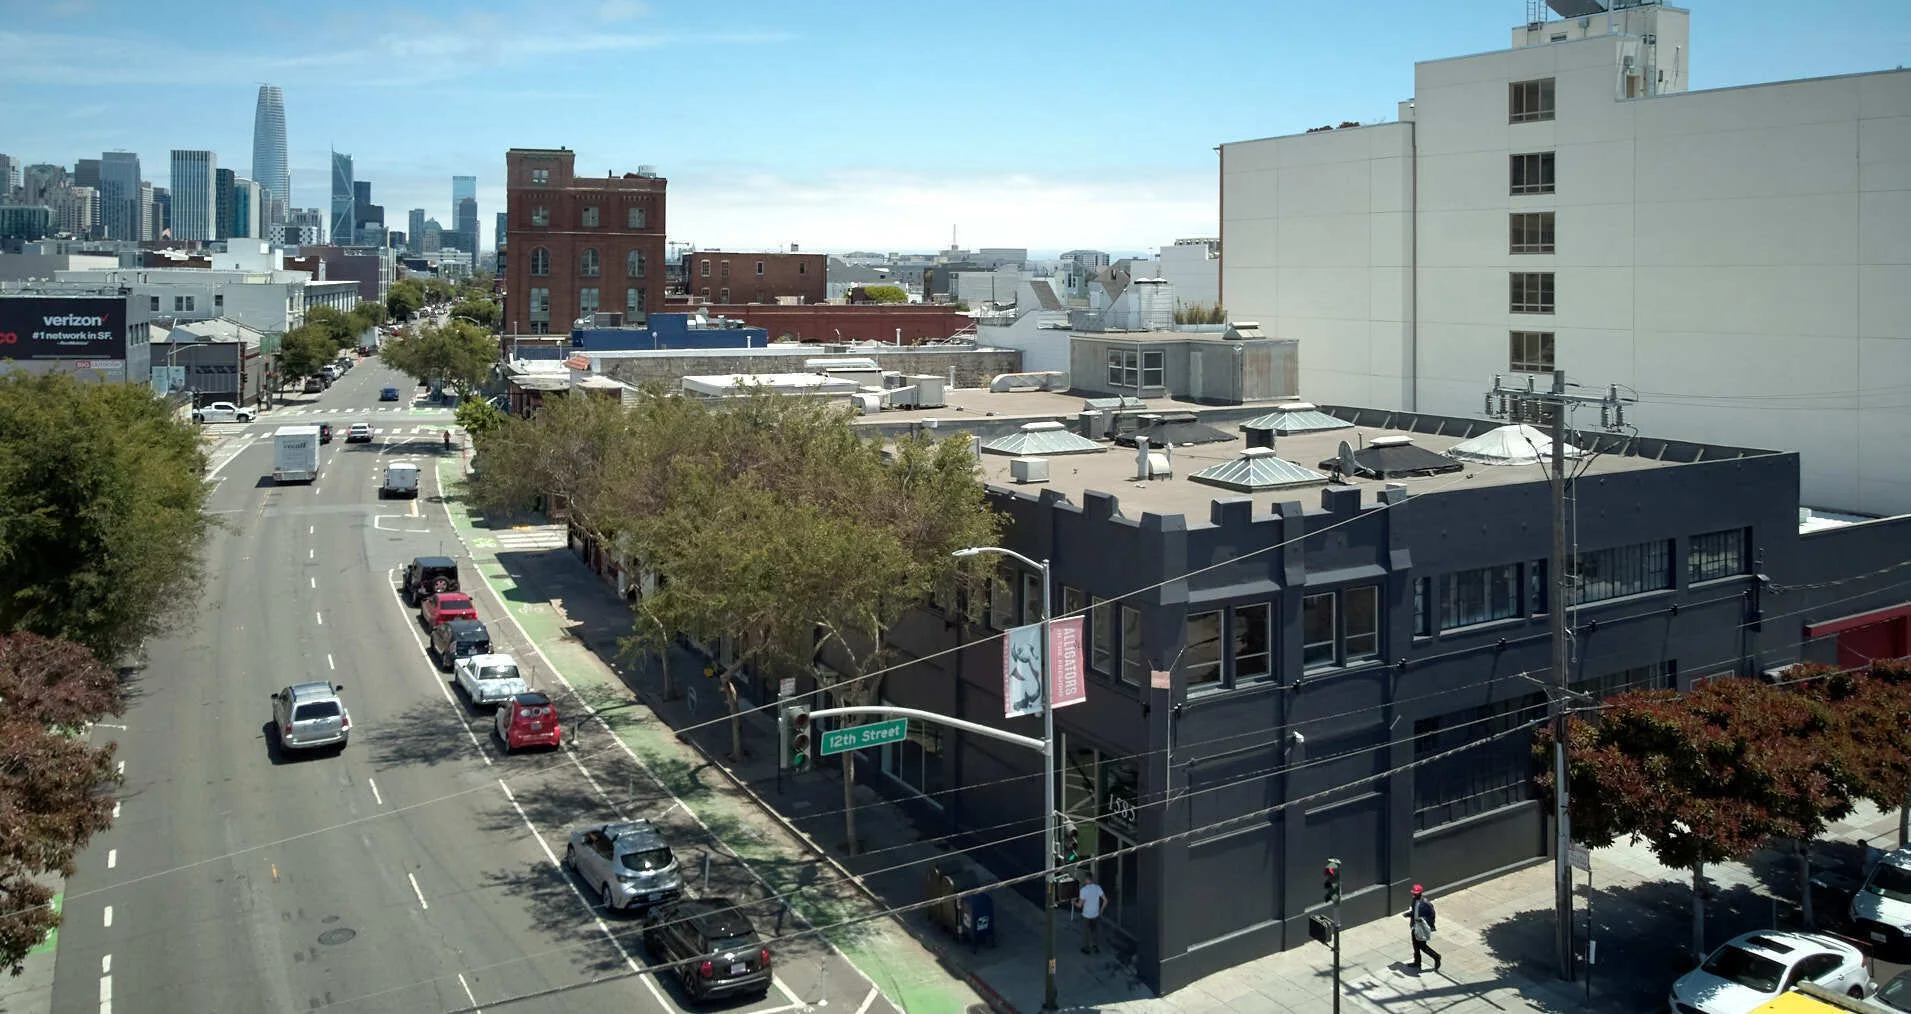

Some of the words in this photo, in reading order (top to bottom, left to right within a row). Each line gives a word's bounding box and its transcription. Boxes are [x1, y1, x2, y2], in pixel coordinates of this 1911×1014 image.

[43, 313, 101, 326] verizon
[32, 331, 45, 339] #1
[46, 331, 86, 339] network
[88, 331, 97, 339] in
[97, 331, 112, 340] SF.
[1063, 628, 1077, 696] ALLIGATORS
[829, 734, 857, 748] 12th
[861, 725, 900, 742] Street
[1109, 793, 1136, 822] 1585
